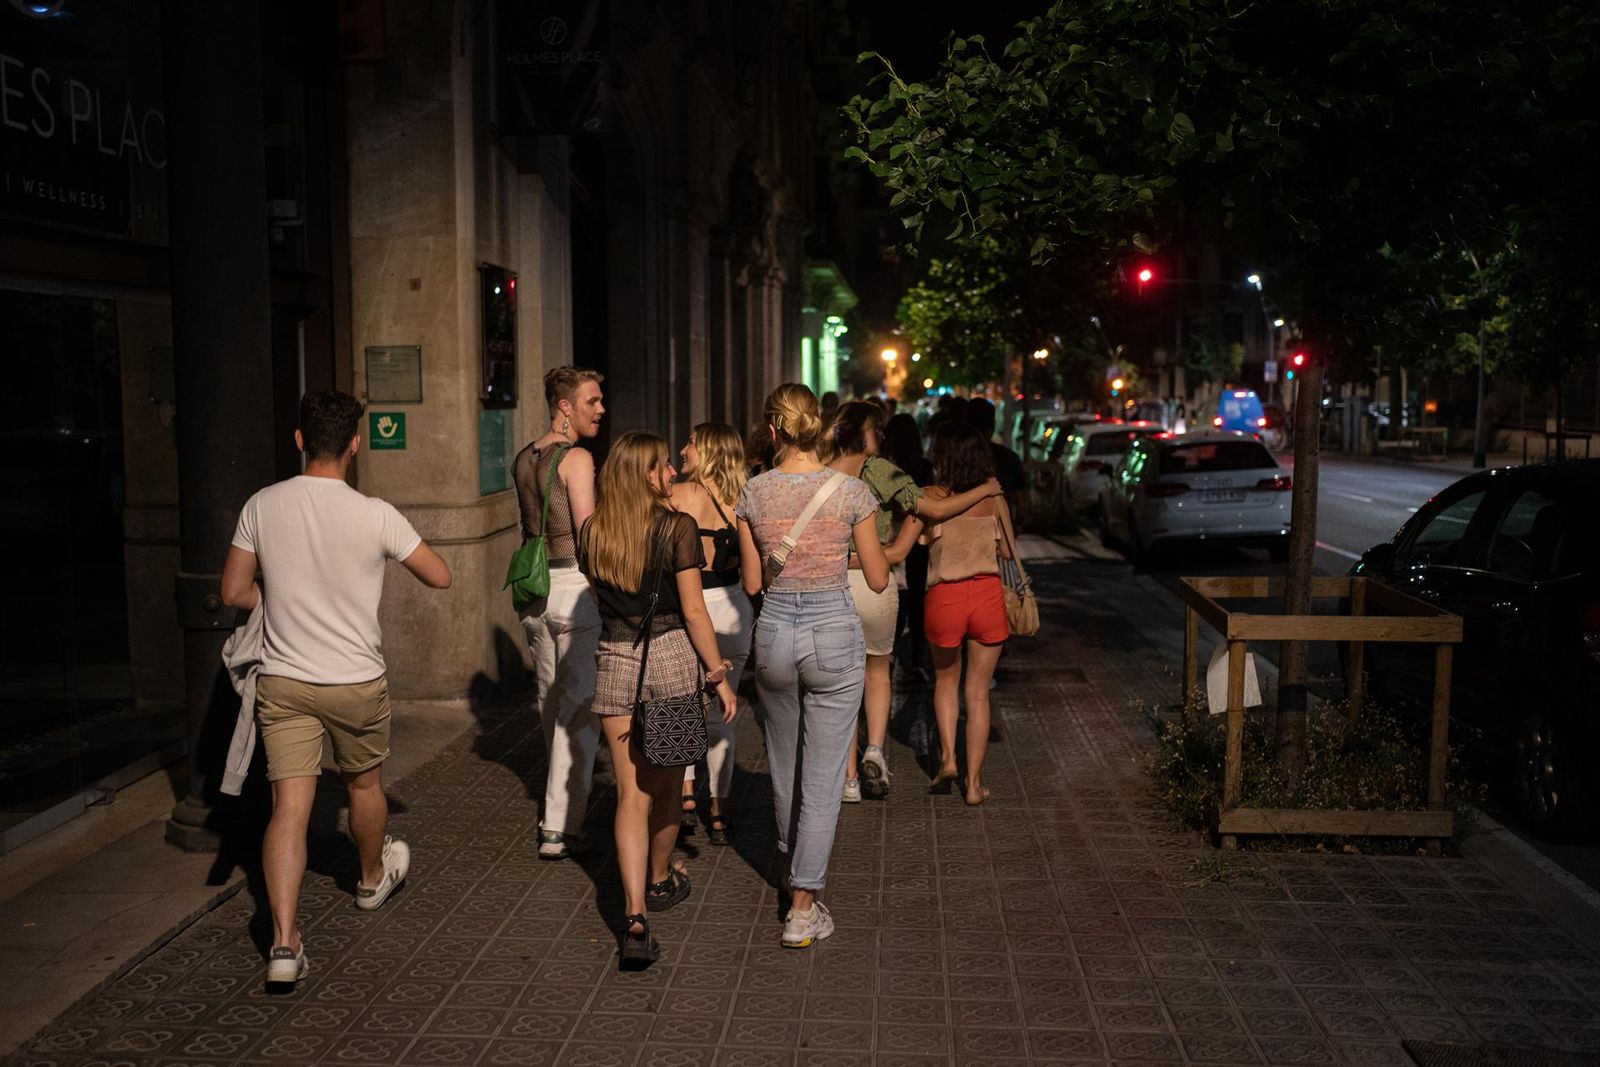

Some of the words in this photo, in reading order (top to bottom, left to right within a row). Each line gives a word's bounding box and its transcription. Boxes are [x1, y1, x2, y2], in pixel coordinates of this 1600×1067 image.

[505, 51, 560, 64] HOLMES
[561, 51, 601, 64] PLACE
[22, 176, 106, 211] WELLNESS
